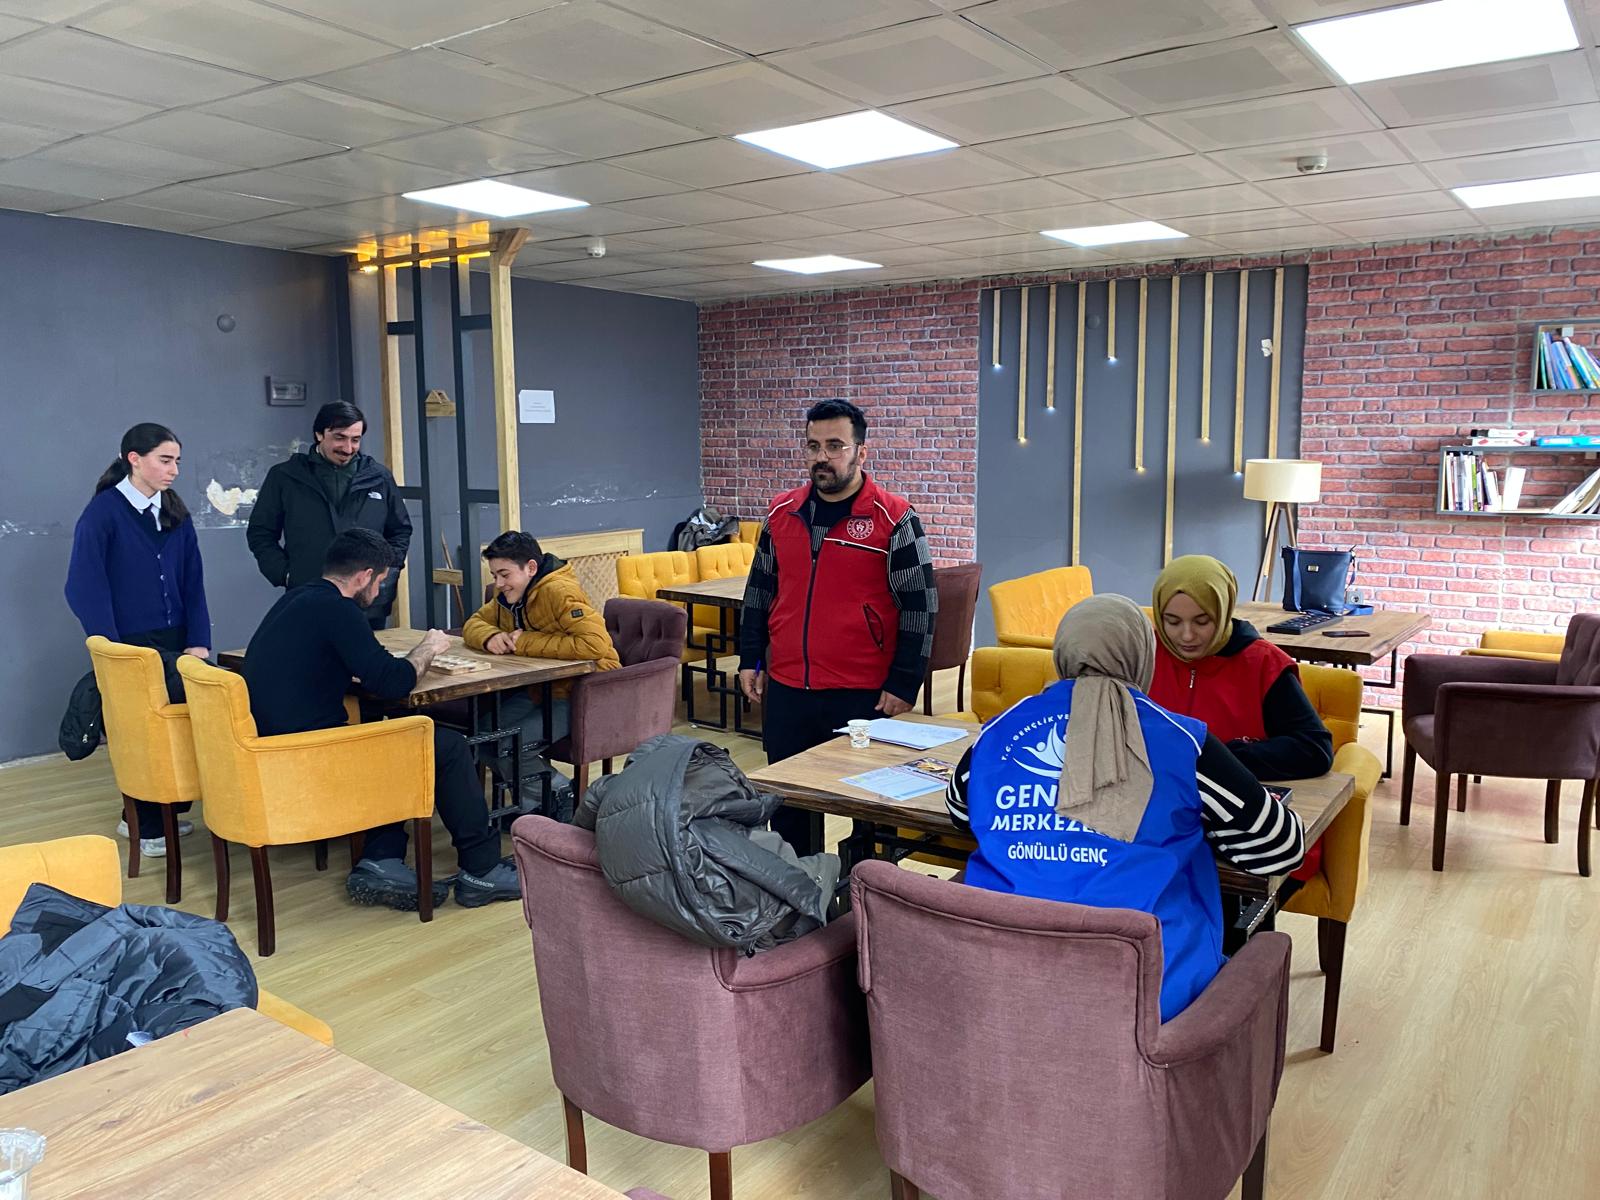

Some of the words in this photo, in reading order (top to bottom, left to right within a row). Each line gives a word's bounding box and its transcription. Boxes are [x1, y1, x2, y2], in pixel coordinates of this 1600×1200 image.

[1001, 743, 1014, 761] T.C.
[995, 783, 1058, 810] GEN
[1008, 841, 1068, 862] GÖNÜLLÜ
[1070, 847, 1108, 867] GENÇ
